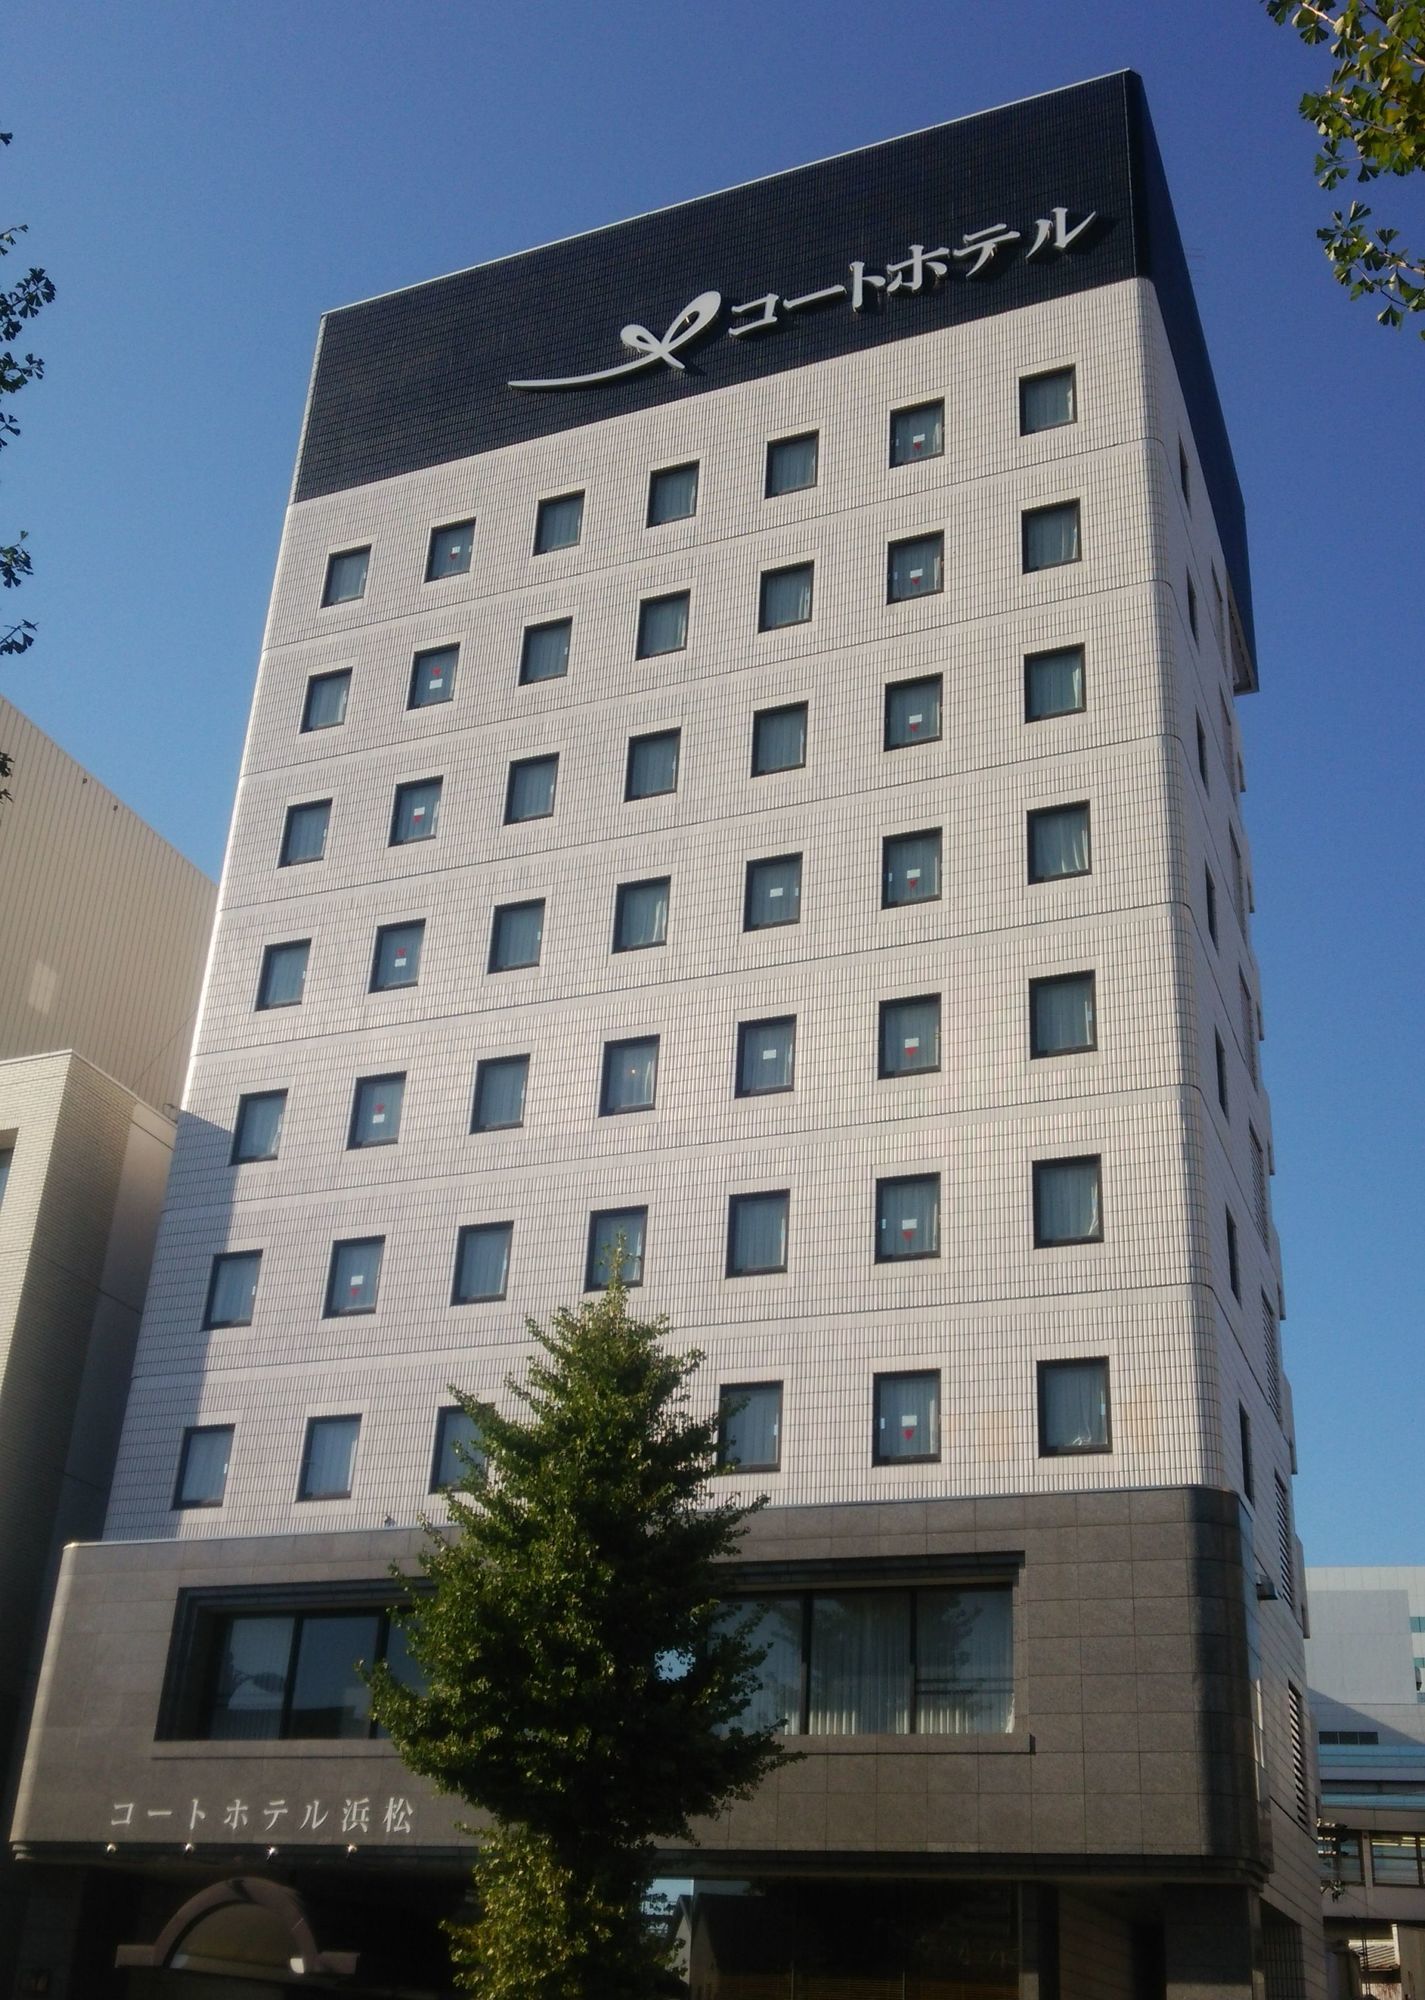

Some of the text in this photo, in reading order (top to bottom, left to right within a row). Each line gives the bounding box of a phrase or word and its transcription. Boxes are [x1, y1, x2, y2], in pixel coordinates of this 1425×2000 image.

[730, 207, 1096, 337] コートホテル
[110, 1797, 414, 1834] コートホテル浜松
